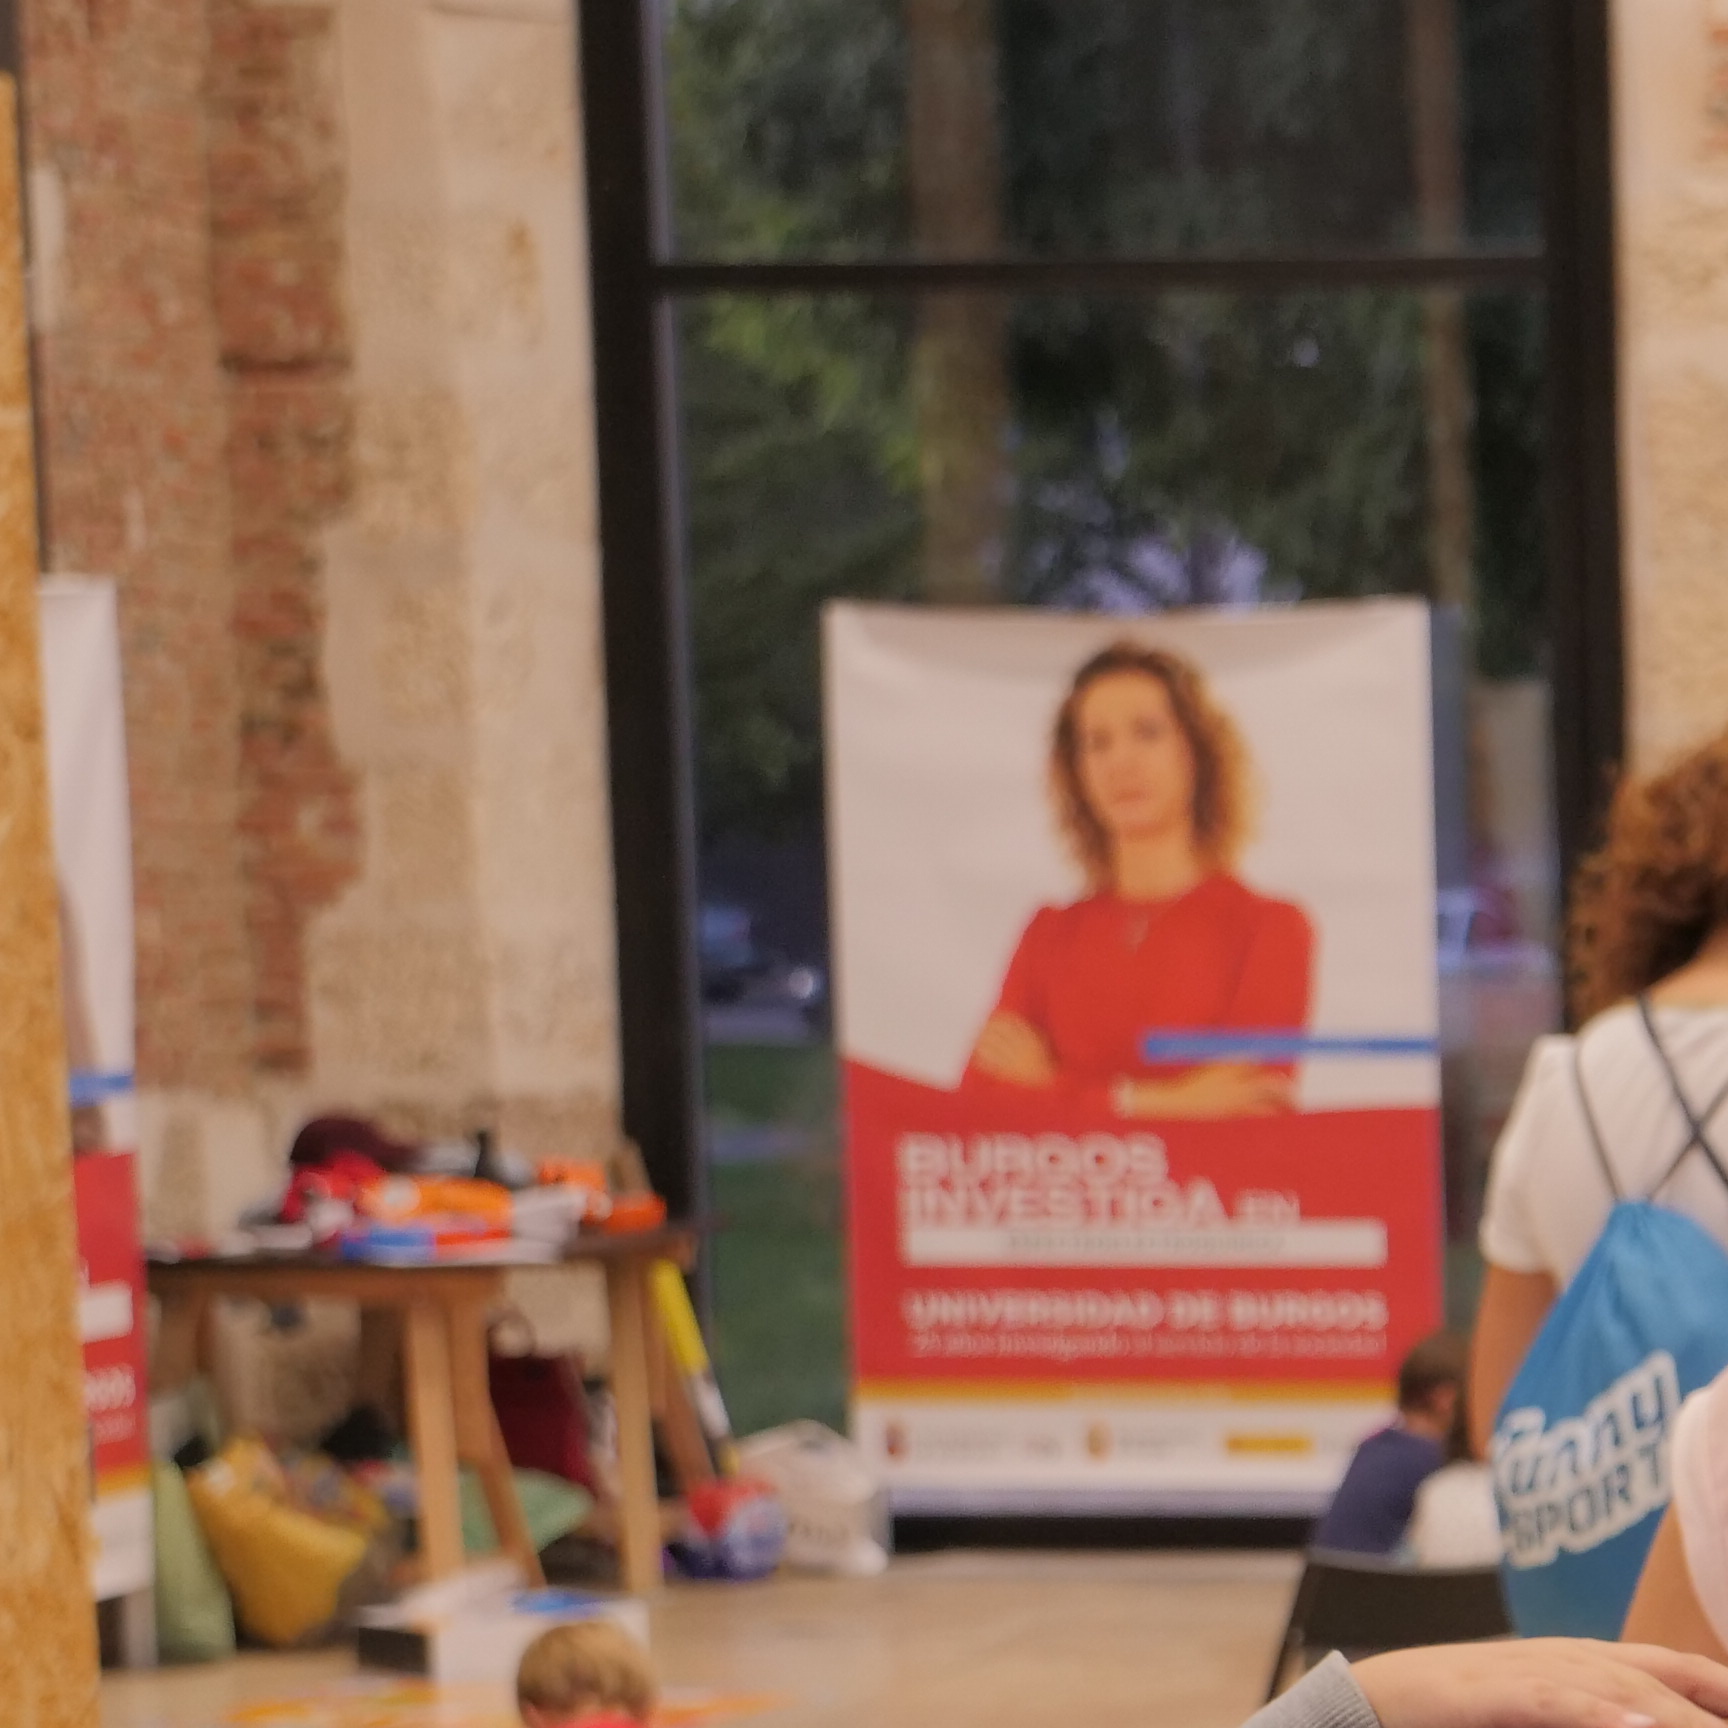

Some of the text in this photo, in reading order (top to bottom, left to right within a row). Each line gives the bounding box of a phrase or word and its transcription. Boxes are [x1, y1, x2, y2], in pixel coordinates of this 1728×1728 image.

[901, 1135, 1167, 1179] BURGOS
[901, 1179, 1228, 1225] INVESTIGA
[908, 1289, 1387, 1330] UNIVERSIDAD DE BURGOS
